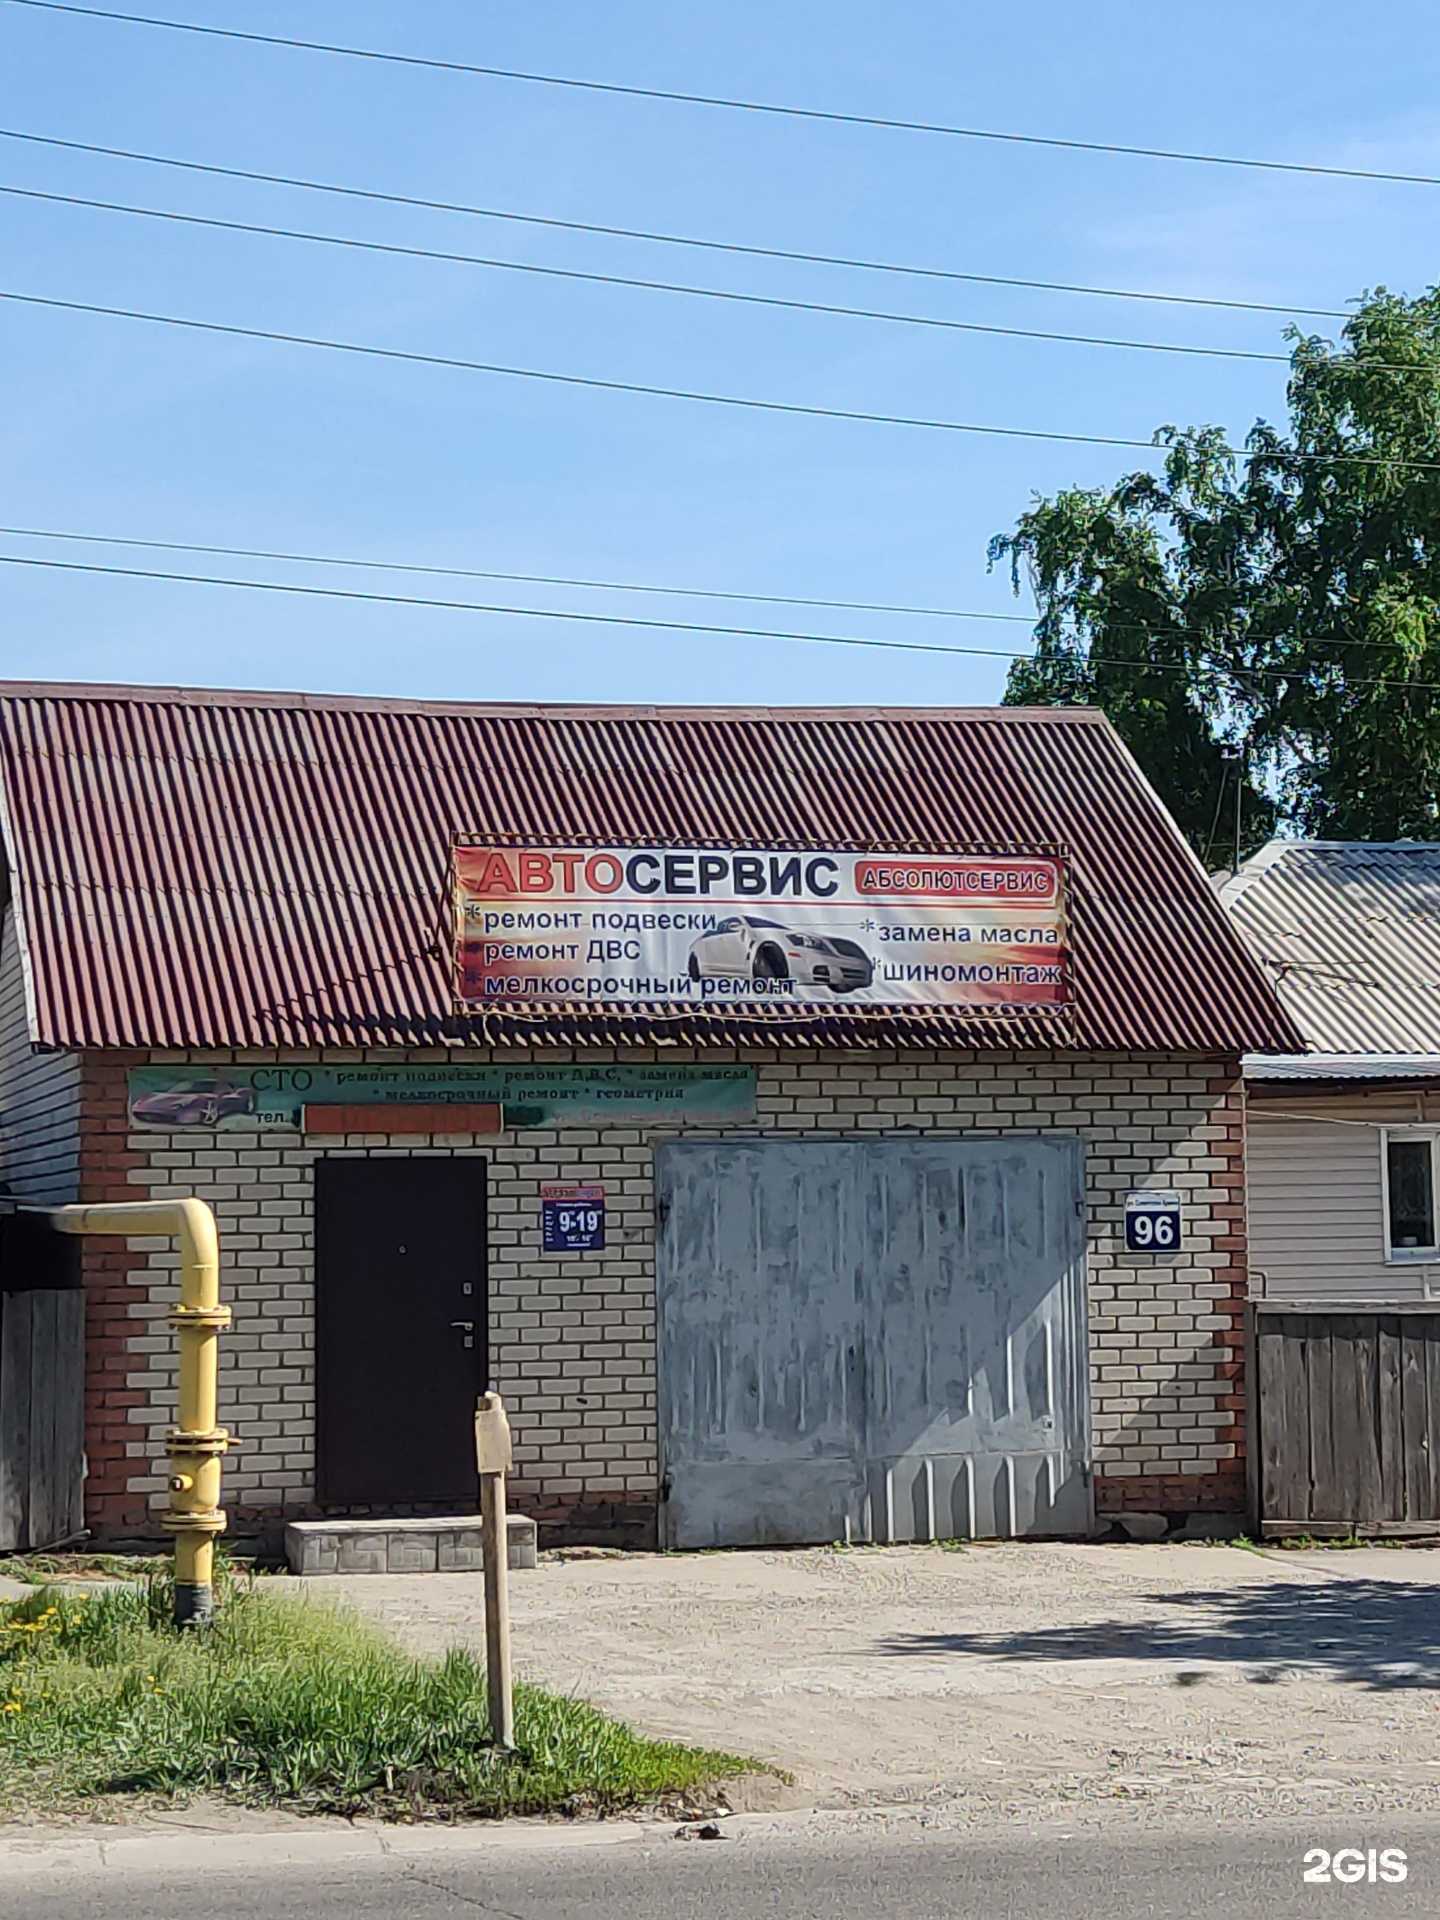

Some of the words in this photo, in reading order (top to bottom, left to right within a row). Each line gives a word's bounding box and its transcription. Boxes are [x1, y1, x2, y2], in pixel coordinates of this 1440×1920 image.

[478, 852, 839, 897] АВТОСЕРВИС
[863, 868, 1049, 892] АБСОЛЮТСЕРВИС
[484, 911, 582, 933] ремонт
[592, 912, 716, 931] подвески
[879, 925, 971, 943] замена
[981, 926, 1058, 944] масла
[484, 944, 579, 965] ремонт
[587, 940, 641, 963] ДВС
[486, 973, 691, 998] мелкосрочный
[701, 977, 797, 998] ремонт
[884, 963, 1061, 984] шиномонтаж
[250, 1069, 312, 1091] СТО
[1134, 1216, 1173, 1245] 96
